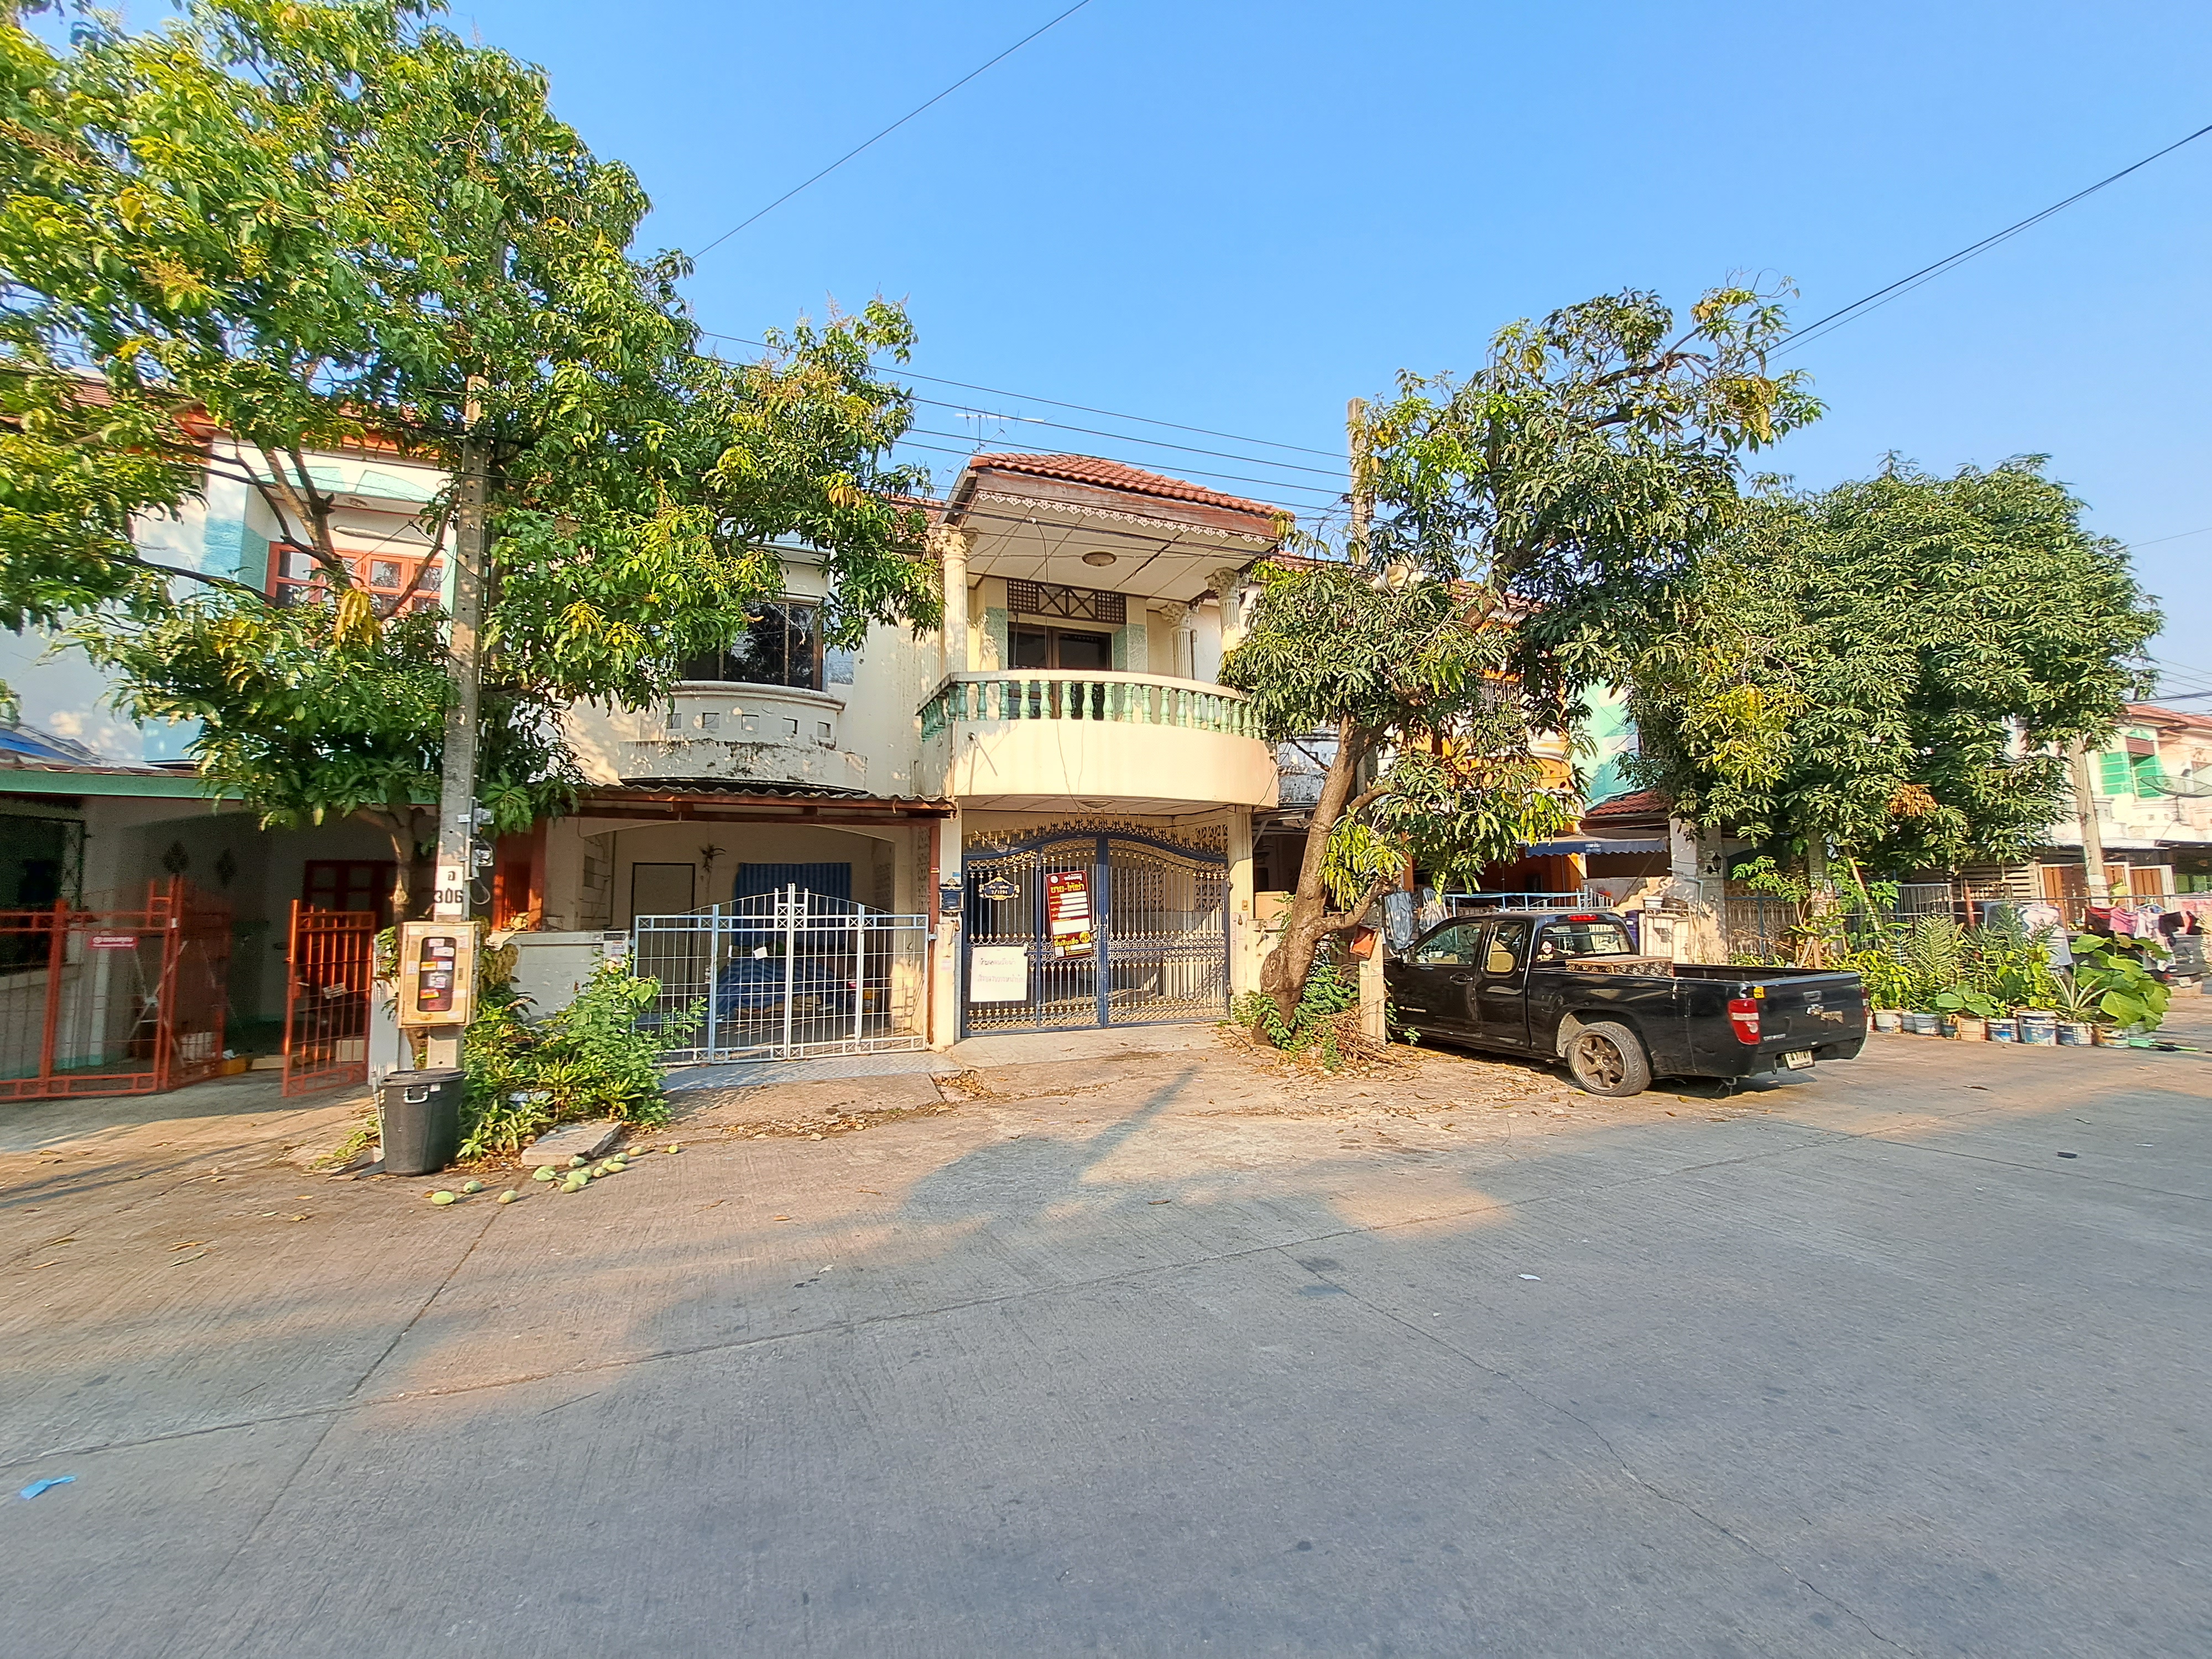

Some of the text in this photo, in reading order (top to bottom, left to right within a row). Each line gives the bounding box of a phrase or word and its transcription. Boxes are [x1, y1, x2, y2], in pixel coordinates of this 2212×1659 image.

[1050, 881, 1084, 894] ขาย-ให้เช่า
[434, 888, 463, 904] 306
